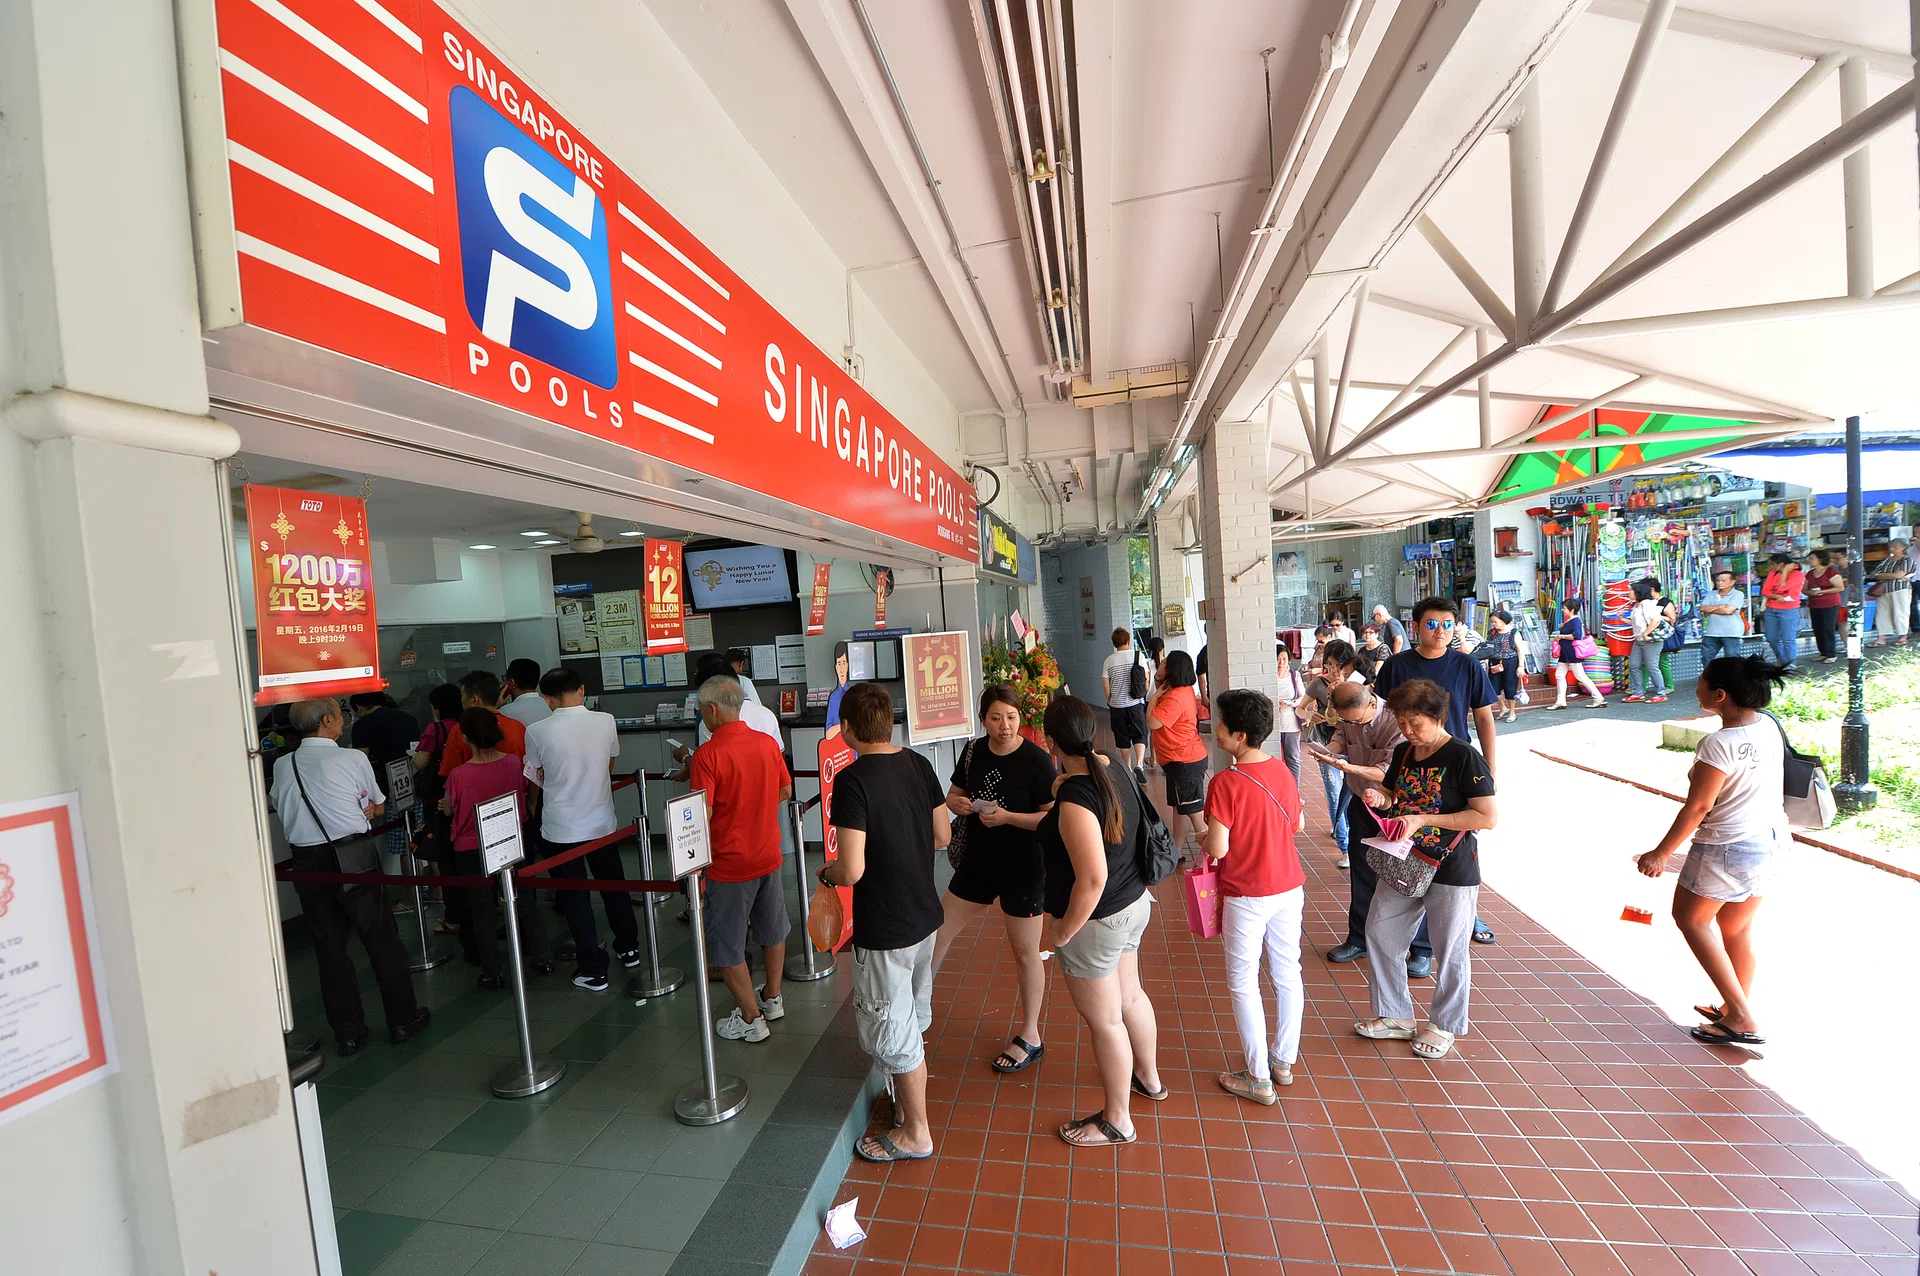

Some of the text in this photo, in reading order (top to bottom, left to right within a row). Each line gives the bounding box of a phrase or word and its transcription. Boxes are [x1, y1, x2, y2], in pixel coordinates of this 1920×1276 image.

[442, 31, 605, 190] SINGAPORE
[469, 342, 625, 430] POOLS
[764, 342, 965, 527] SINGAPORE POOLS
[302, 500, 322, 511] TOTO
[260, 540, 269, 551] $
[265, 553, 363, 586] 1200万
[649, 565, 679, 603] 12
[268, 587, 366, 612] 红包大奖
[650, 603, 679, 613] MILLION
[309, 623, 364, 633] 2016年2月19日
[298, 634, 346, 644] 晚上9时30分
[918, 654, 958, 688] 12
[920, 685, 959, 697] MILLION
[677, 829, 701, 842] Queue Here
[682, 824, 695, 832] Please
[8, 960, 40, 977] YEAR
